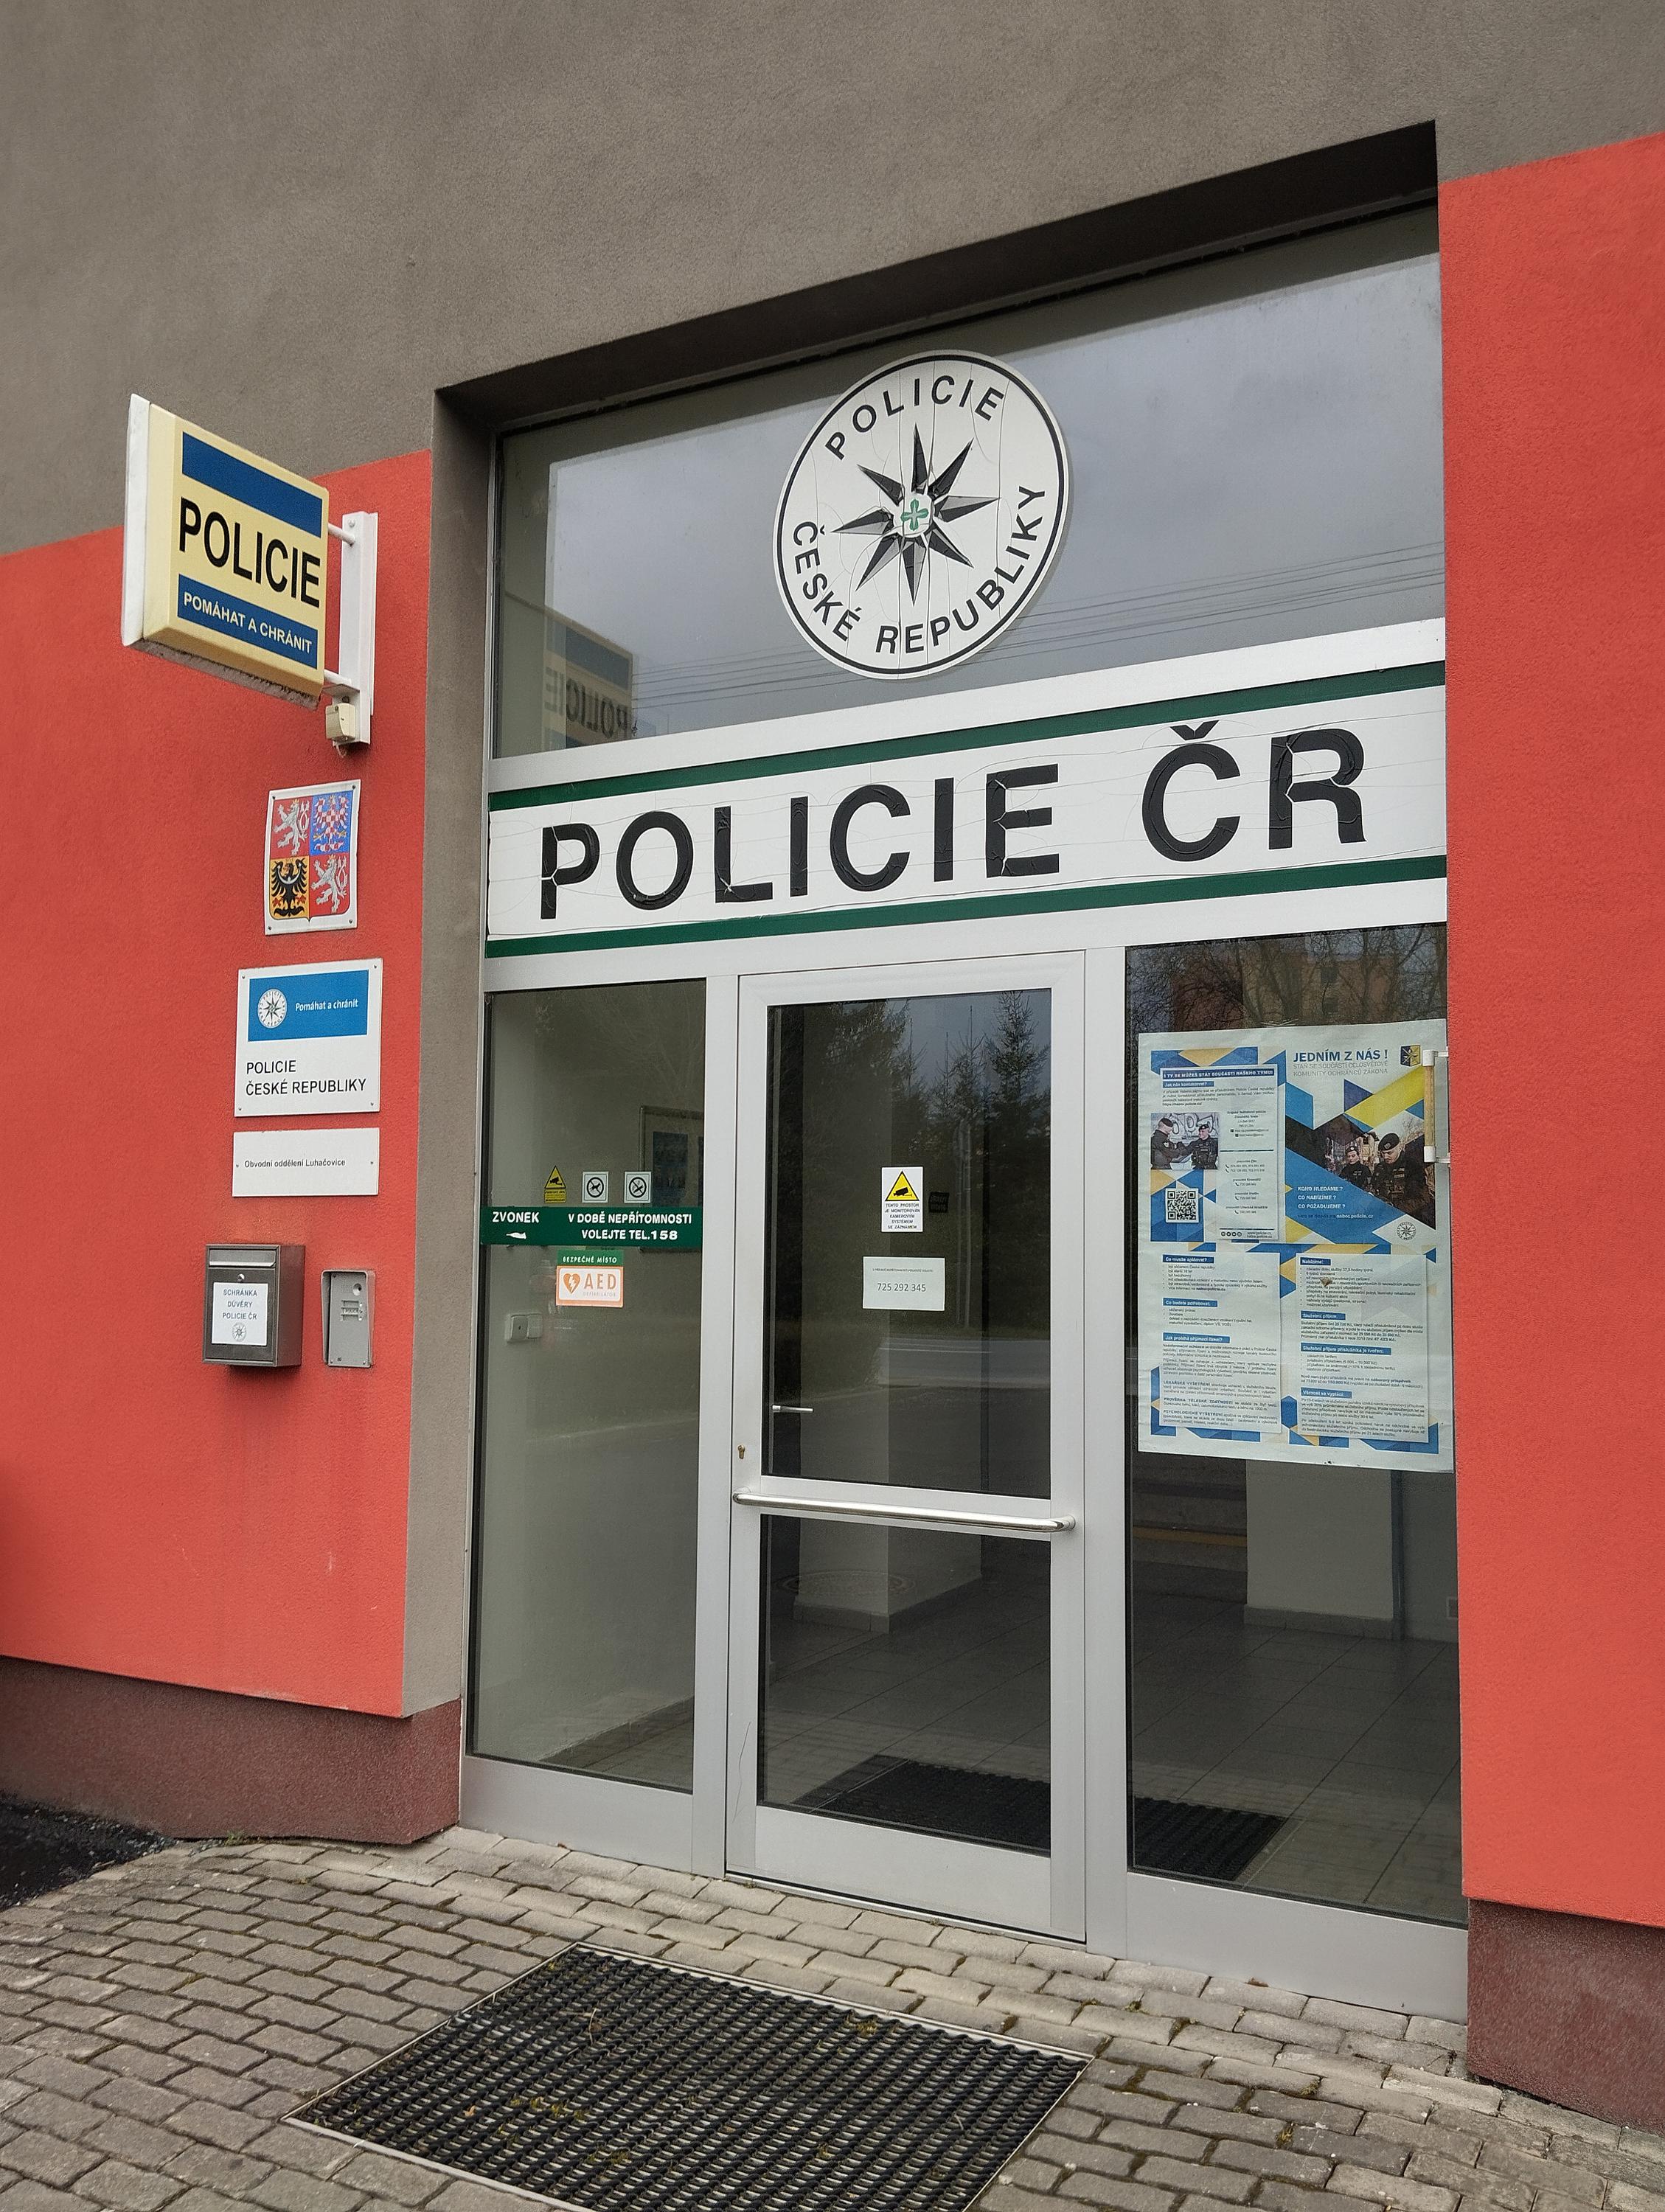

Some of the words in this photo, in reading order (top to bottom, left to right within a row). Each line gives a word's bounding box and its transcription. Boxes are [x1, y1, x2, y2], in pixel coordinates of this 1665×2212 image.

[825, 375, 1004, 460] POLICIE
[179, 497, 321, 608] POLICIE
[793, 521, 863, 641] ČESKÉ
[875, 486, 1046, 654] REPUBLIKY
[184, 591, 246, 627] POMÁHAT
[248, 618, 257, 630] A
[260, 624, 313, 654] CHRÁNIT
[540, 763, 1060, 920] POLICIE
[1141, 720, 1367, 862] ČR
[295, 1000, 326, 1012] Pomáhat
[333, 998, 358, 1009] chránit
[1293, 1048, 1341, 1062] JEDNÍM
[1344, 1051, 1352, 1061] Z
[1356, 1047, 1380, 1060] NÁS
[1384, 1049, 1388, 1059] !
[246, 1060, 296, 1074] POLICIE
[1363, 1067, 1388, 1075] ZÁKONA
[246, 1079, 288, 1096] ČESKÉ
[292, 1078, 366, 1094] REPUBLIKY
[245, 1159, 273, 1168] Obvodní
[274, 1158, 304, 1167] oddělení
[305, 1158, 345, 1166] Luhačovice
[492, 1211, 540, 1223] ZVONEK
[568, 1213, 574, 1223] V
[577, 1211, 605, 1224] DOBĚ
[608, 1210, 692, 1224] NEPŘÍTOMNOSTI
[582, 1229, 626, 1239] VOLEJTE
[563, 1255, 594, 1263] BEZPEČNÉ
[597, 1255, 617, 1264] MÍSTO
[583, 1273, 616, 1290] AED
[877, 1283, 891, 1291] 725
[894, 1283, 908, 1291] 292
[911, 1284, 926, 1292] 345
[223, 1289, 257, 1297] SCHRÁNKA
[227, 1300, 253, 1308] DŮVĚRY
[248, 1312, 257, 1320] ČR
